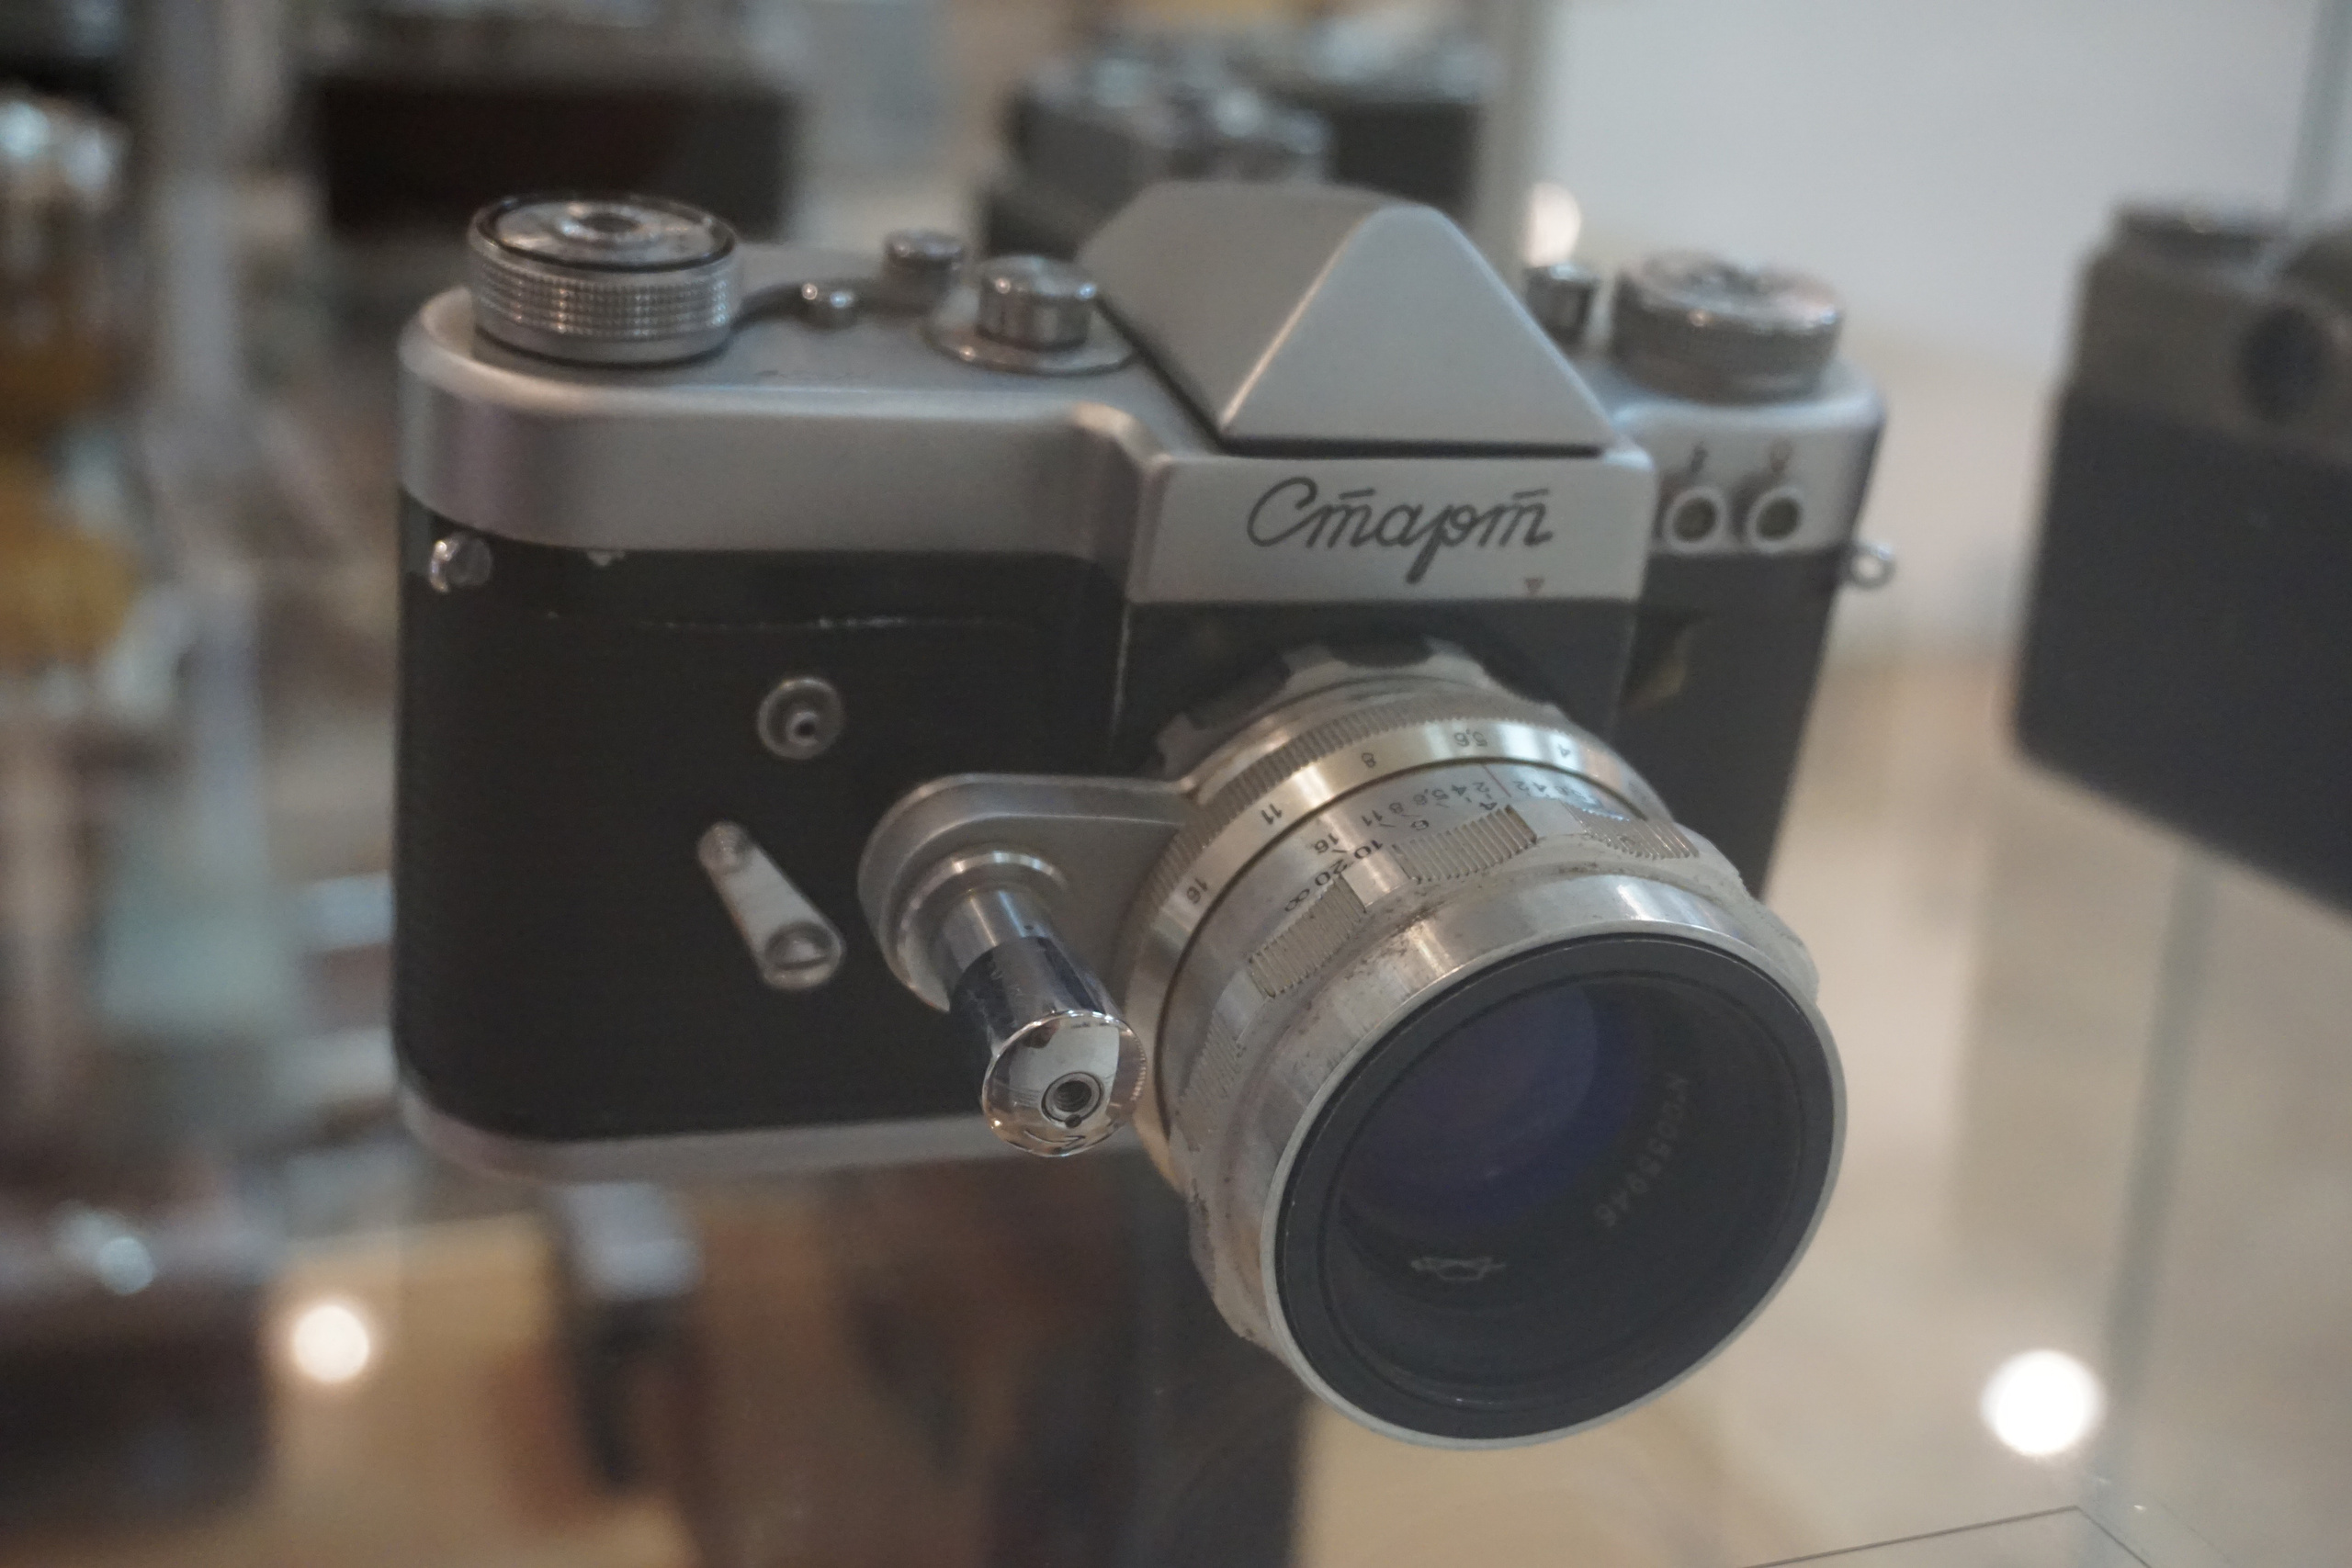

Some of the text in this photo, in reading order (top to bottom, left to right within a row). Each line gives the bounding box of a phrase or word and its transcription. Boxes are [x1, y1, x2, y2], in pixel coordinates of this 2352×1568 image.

[1247, 476, 1553, 584] Старт
[1361, 752, 1376, 768] 8
[1261, 803, 1283, 825] 11
[1362, 809, 1383, 827] 11
[1314, 833, 1339, 854] 16
[1354, 840, 1383, 860] 10
[1315, 859, 1348, 886] 20
[1186, 877, 1209, 904] 16
